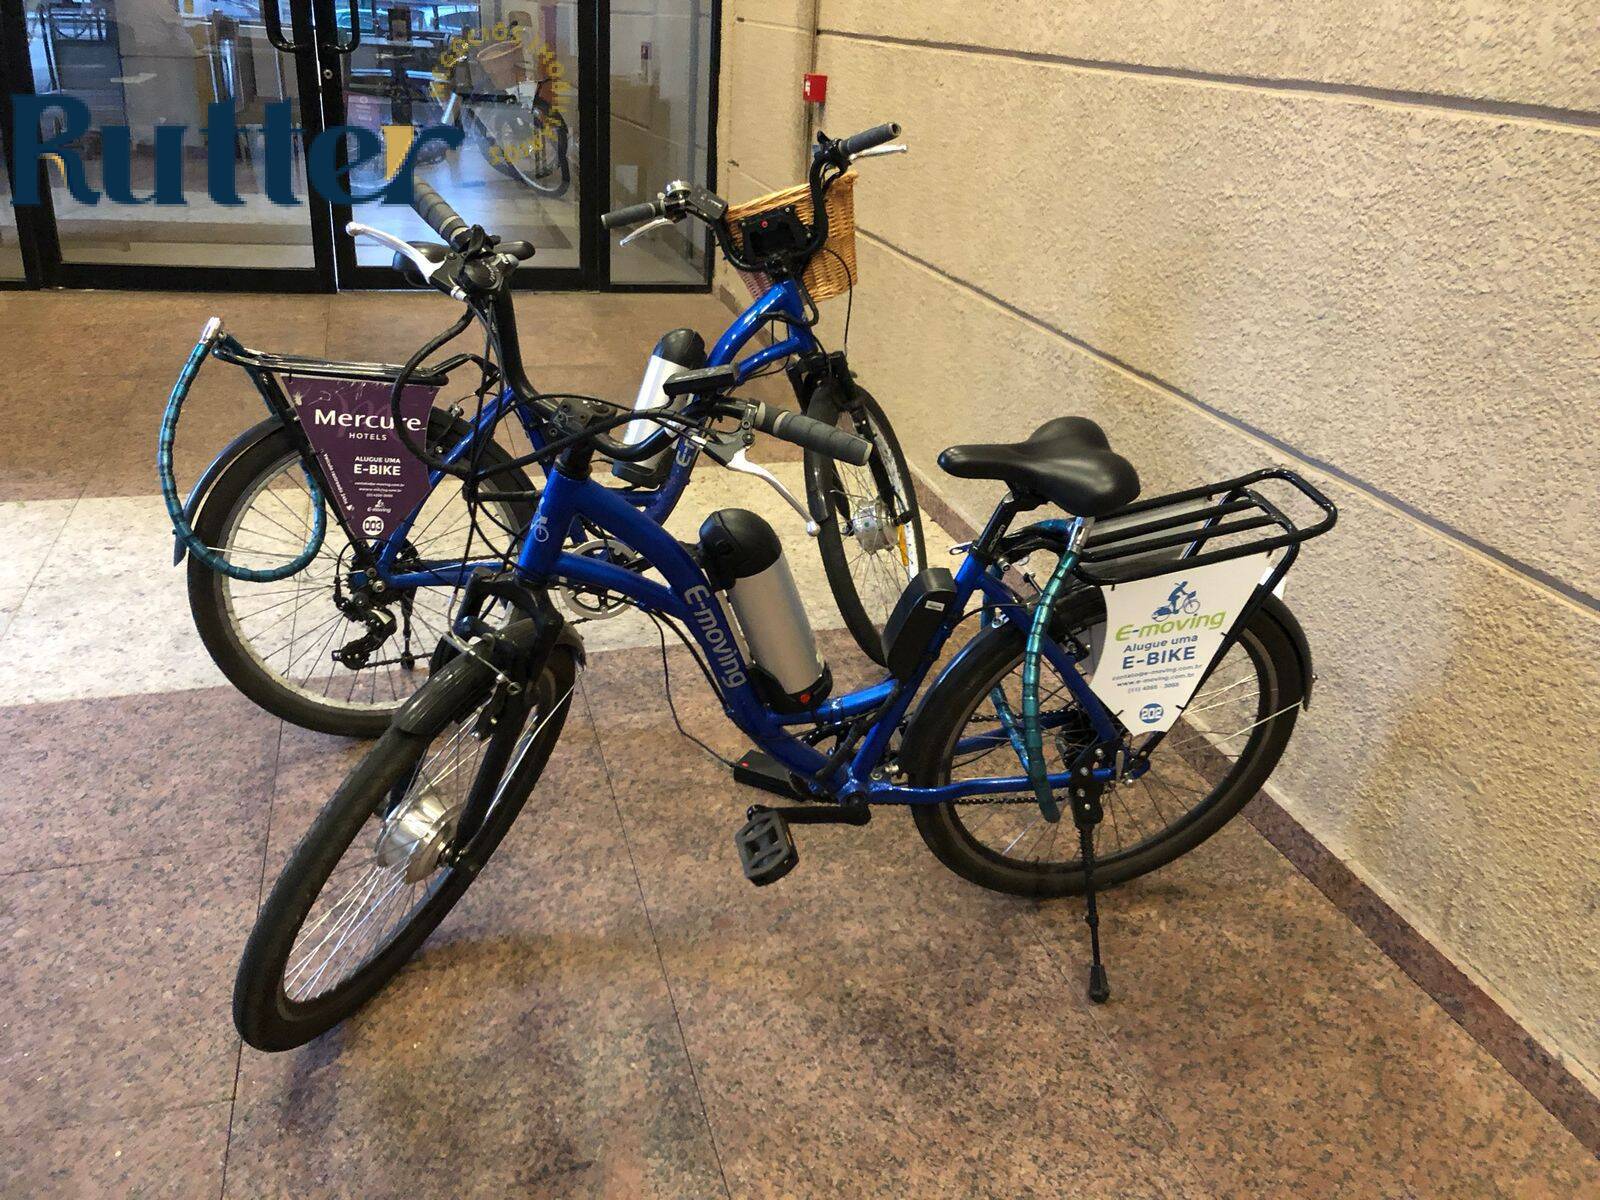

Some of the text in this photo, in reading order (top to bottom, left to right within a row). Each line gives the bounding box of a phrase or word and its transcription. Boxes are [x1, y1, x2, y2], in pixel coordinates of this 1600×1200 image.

[349, 432, 387, 441] HOTELS
[384, 456, 401, 464] UMA
[353, 463, 401, 476] E-BIKE
[1115, 611, 1226, 642] E-moving
[683, 585, 747, 689] E-moving
[1123, 634, 1199, 653] Alugue uma
[1122, 646, 1196, 670] E-BIKE
[1141, 707, 1163, 720] 202
